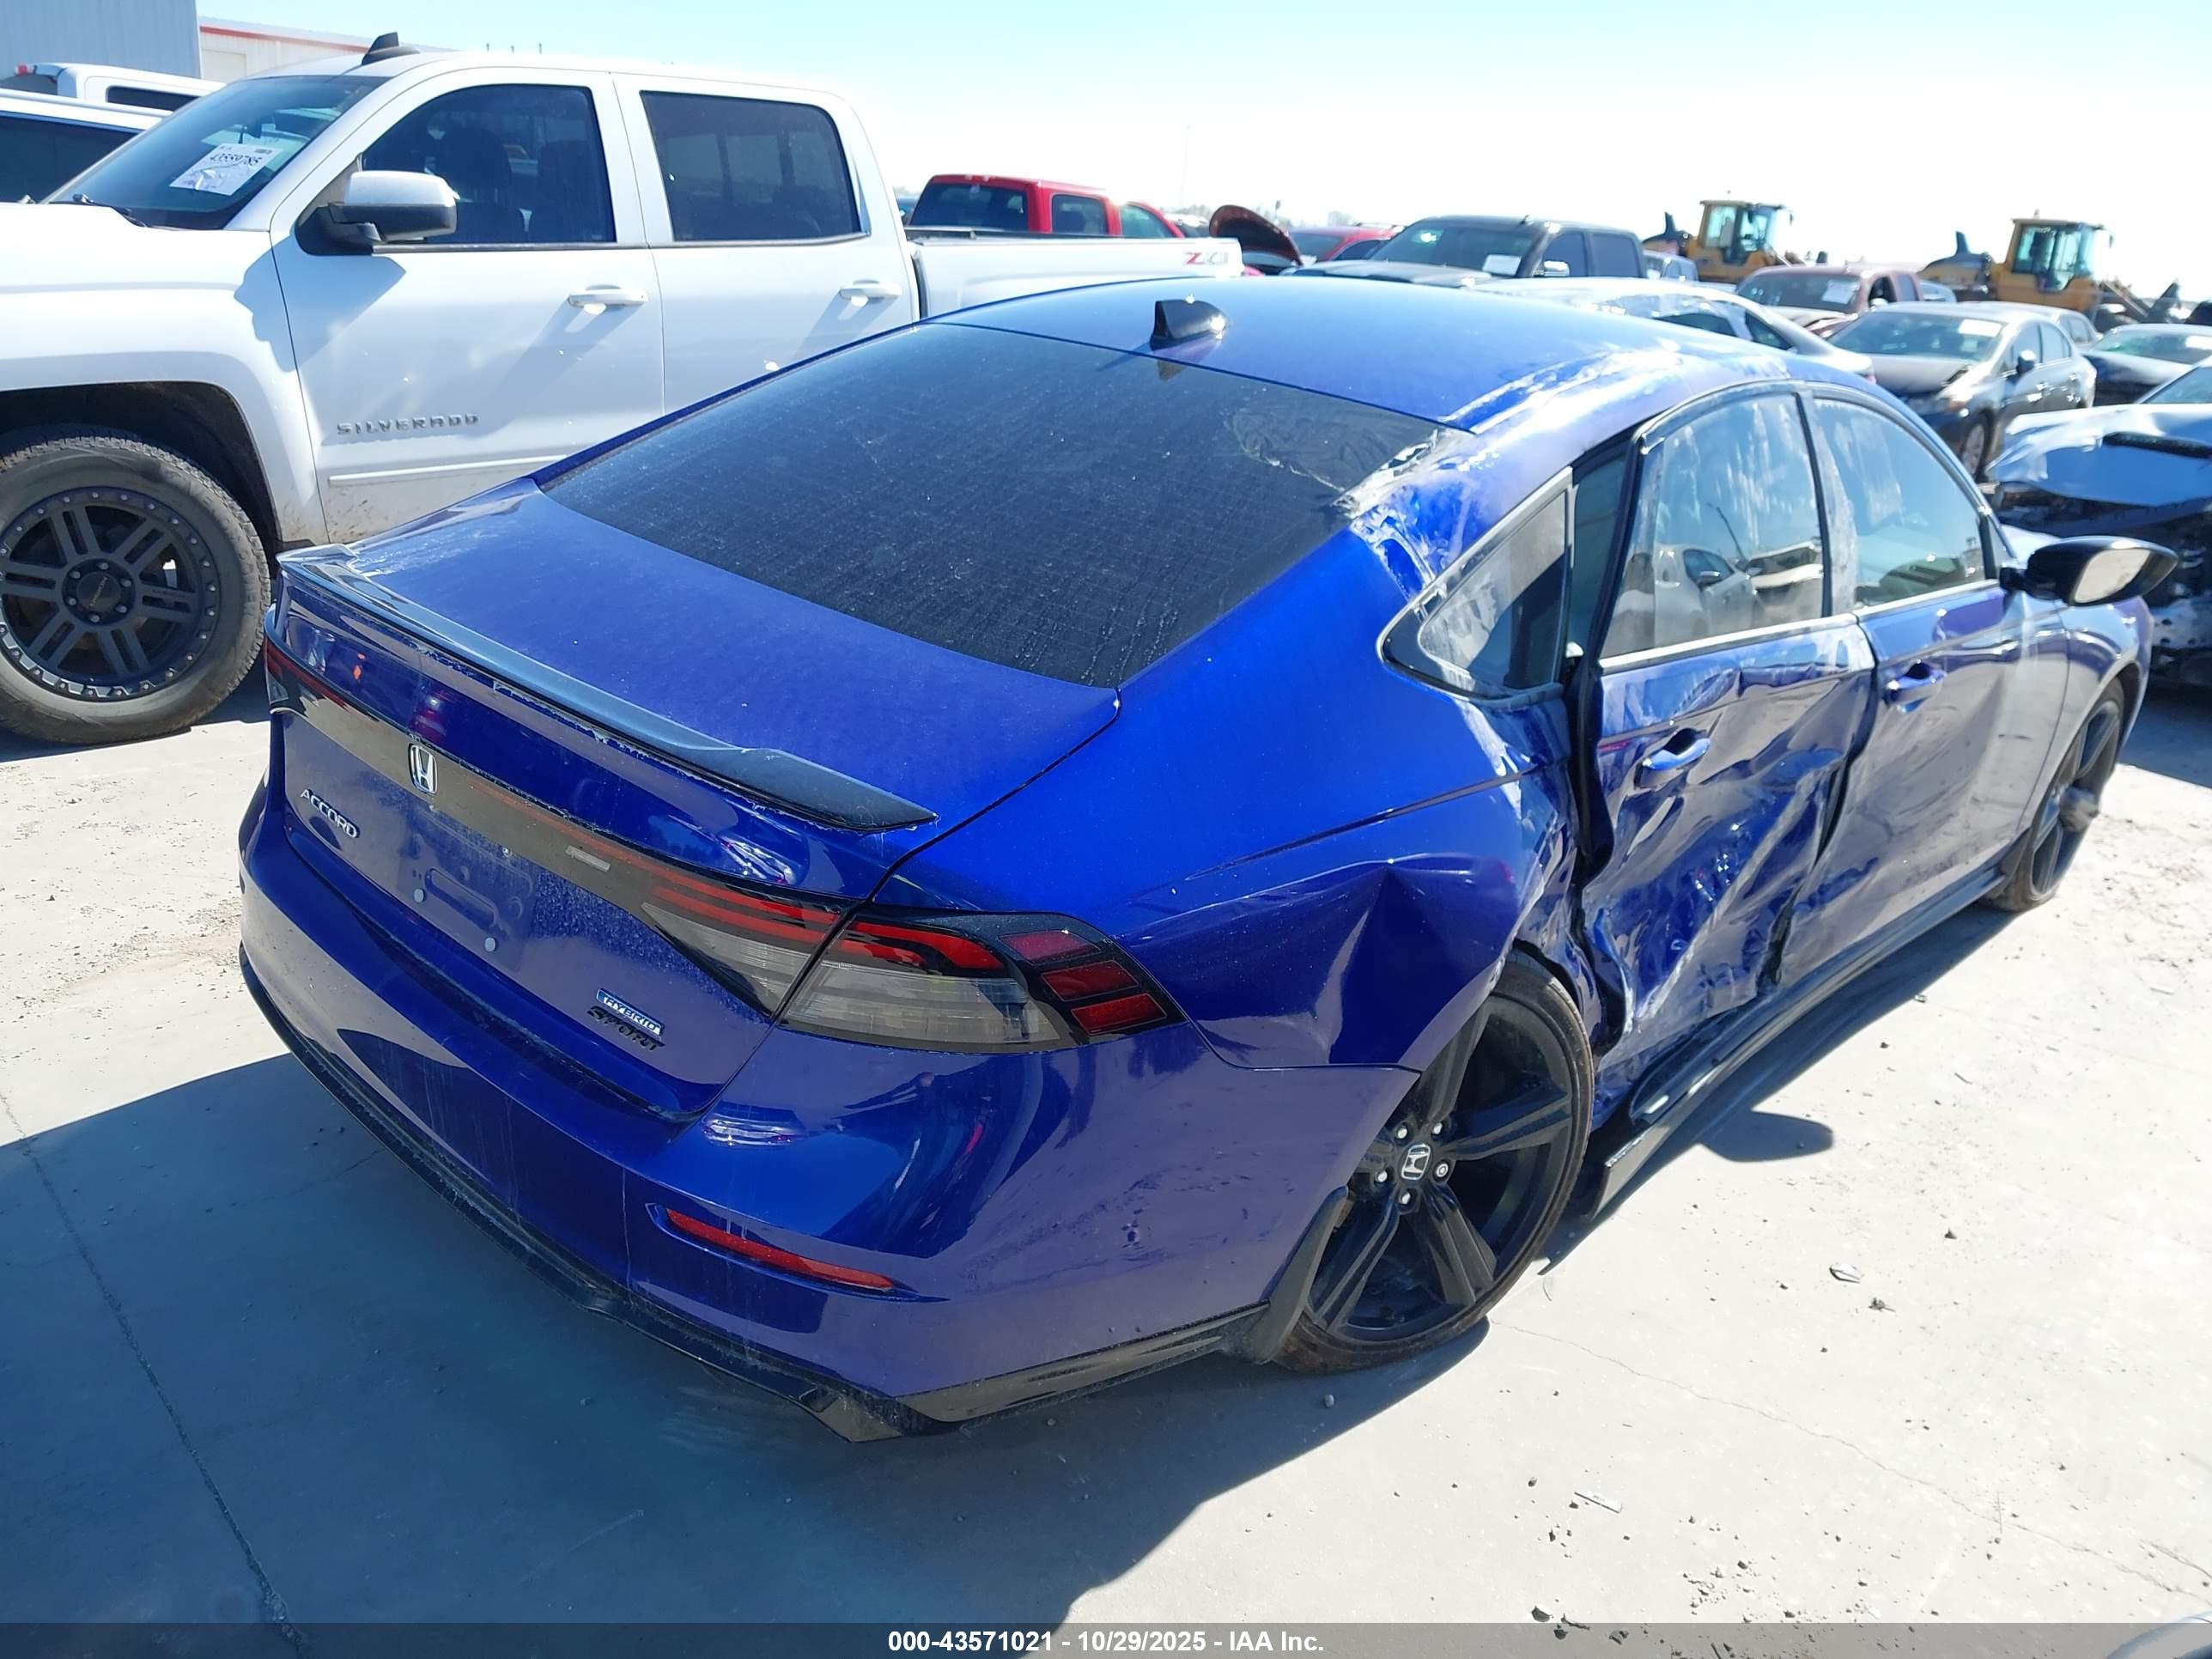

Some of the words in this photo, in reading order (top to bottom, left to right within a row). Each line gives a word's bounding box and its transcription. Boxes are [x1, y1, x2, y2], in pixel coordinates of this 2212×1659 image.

[337, 414, 479, 435] SILVERADO
[301, 788, 360, 839] ACCORD
[604, 996, 659, 1033] HYBRID
